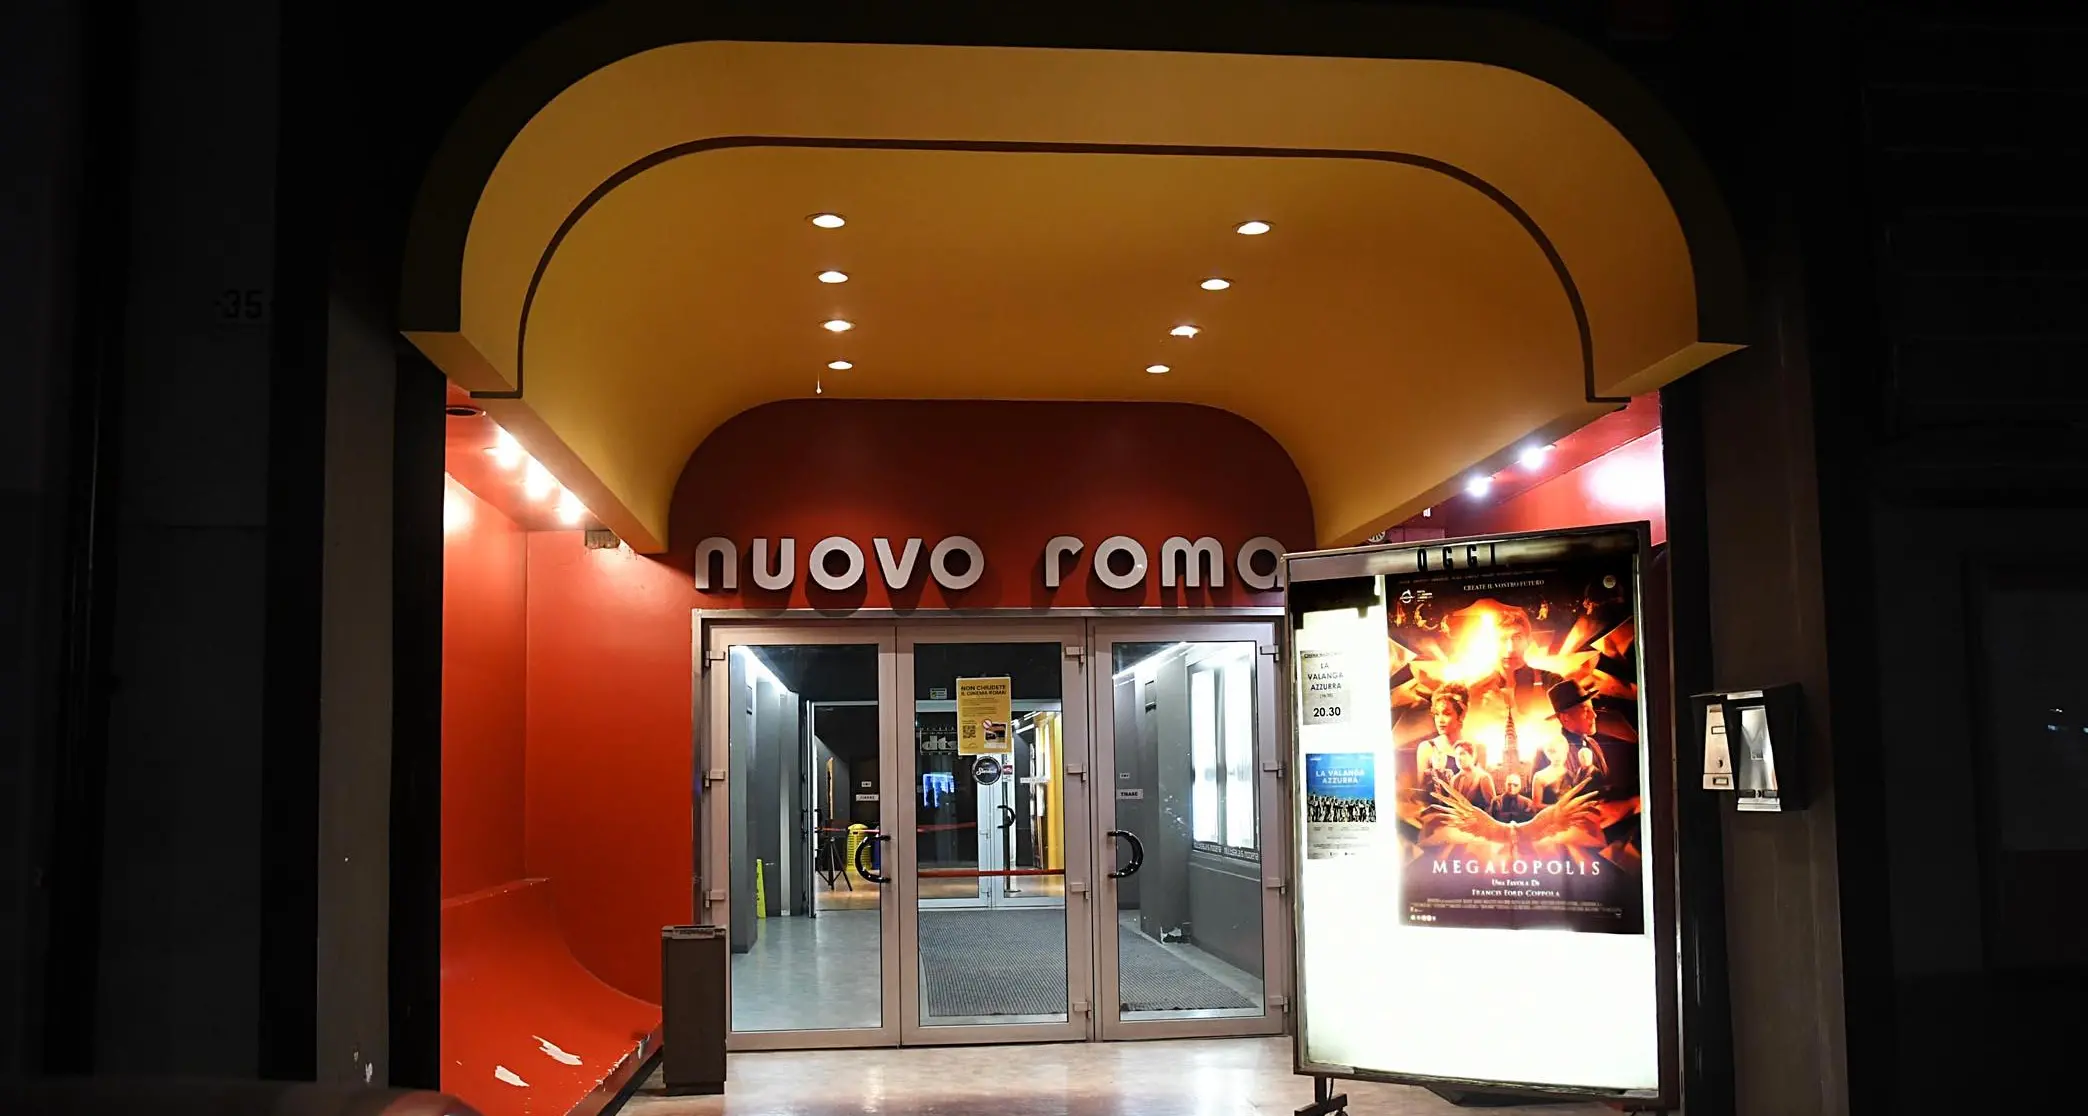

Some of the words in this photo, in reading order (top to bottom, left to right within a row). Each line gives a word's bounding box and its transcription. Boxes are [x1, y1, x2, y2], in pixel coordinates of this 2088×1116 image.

[221, 288, 264, 320] 35
[694, 535, 986, 591] nuovo
[1045, 535, 1286, 591] roma
[1416, 543, 1496, 573] OGGI
[1463, 583, 1486, 591] CREATE
[1519, 579, 1545, 587] FUTURO
[1307, 671, 1344, 681] VALANGA
[1310, 682, 1342, 691] AZZURRA
[1313, 706, 1341, 718] 20.30
[1315, 770, 1326, 778] LA
[1327, 768, 1366, 777] VALANGA
[1322, 777, 1359, 785] AZZURRA
[1432, 859, 1601, 876] MEGALOPOLIS
